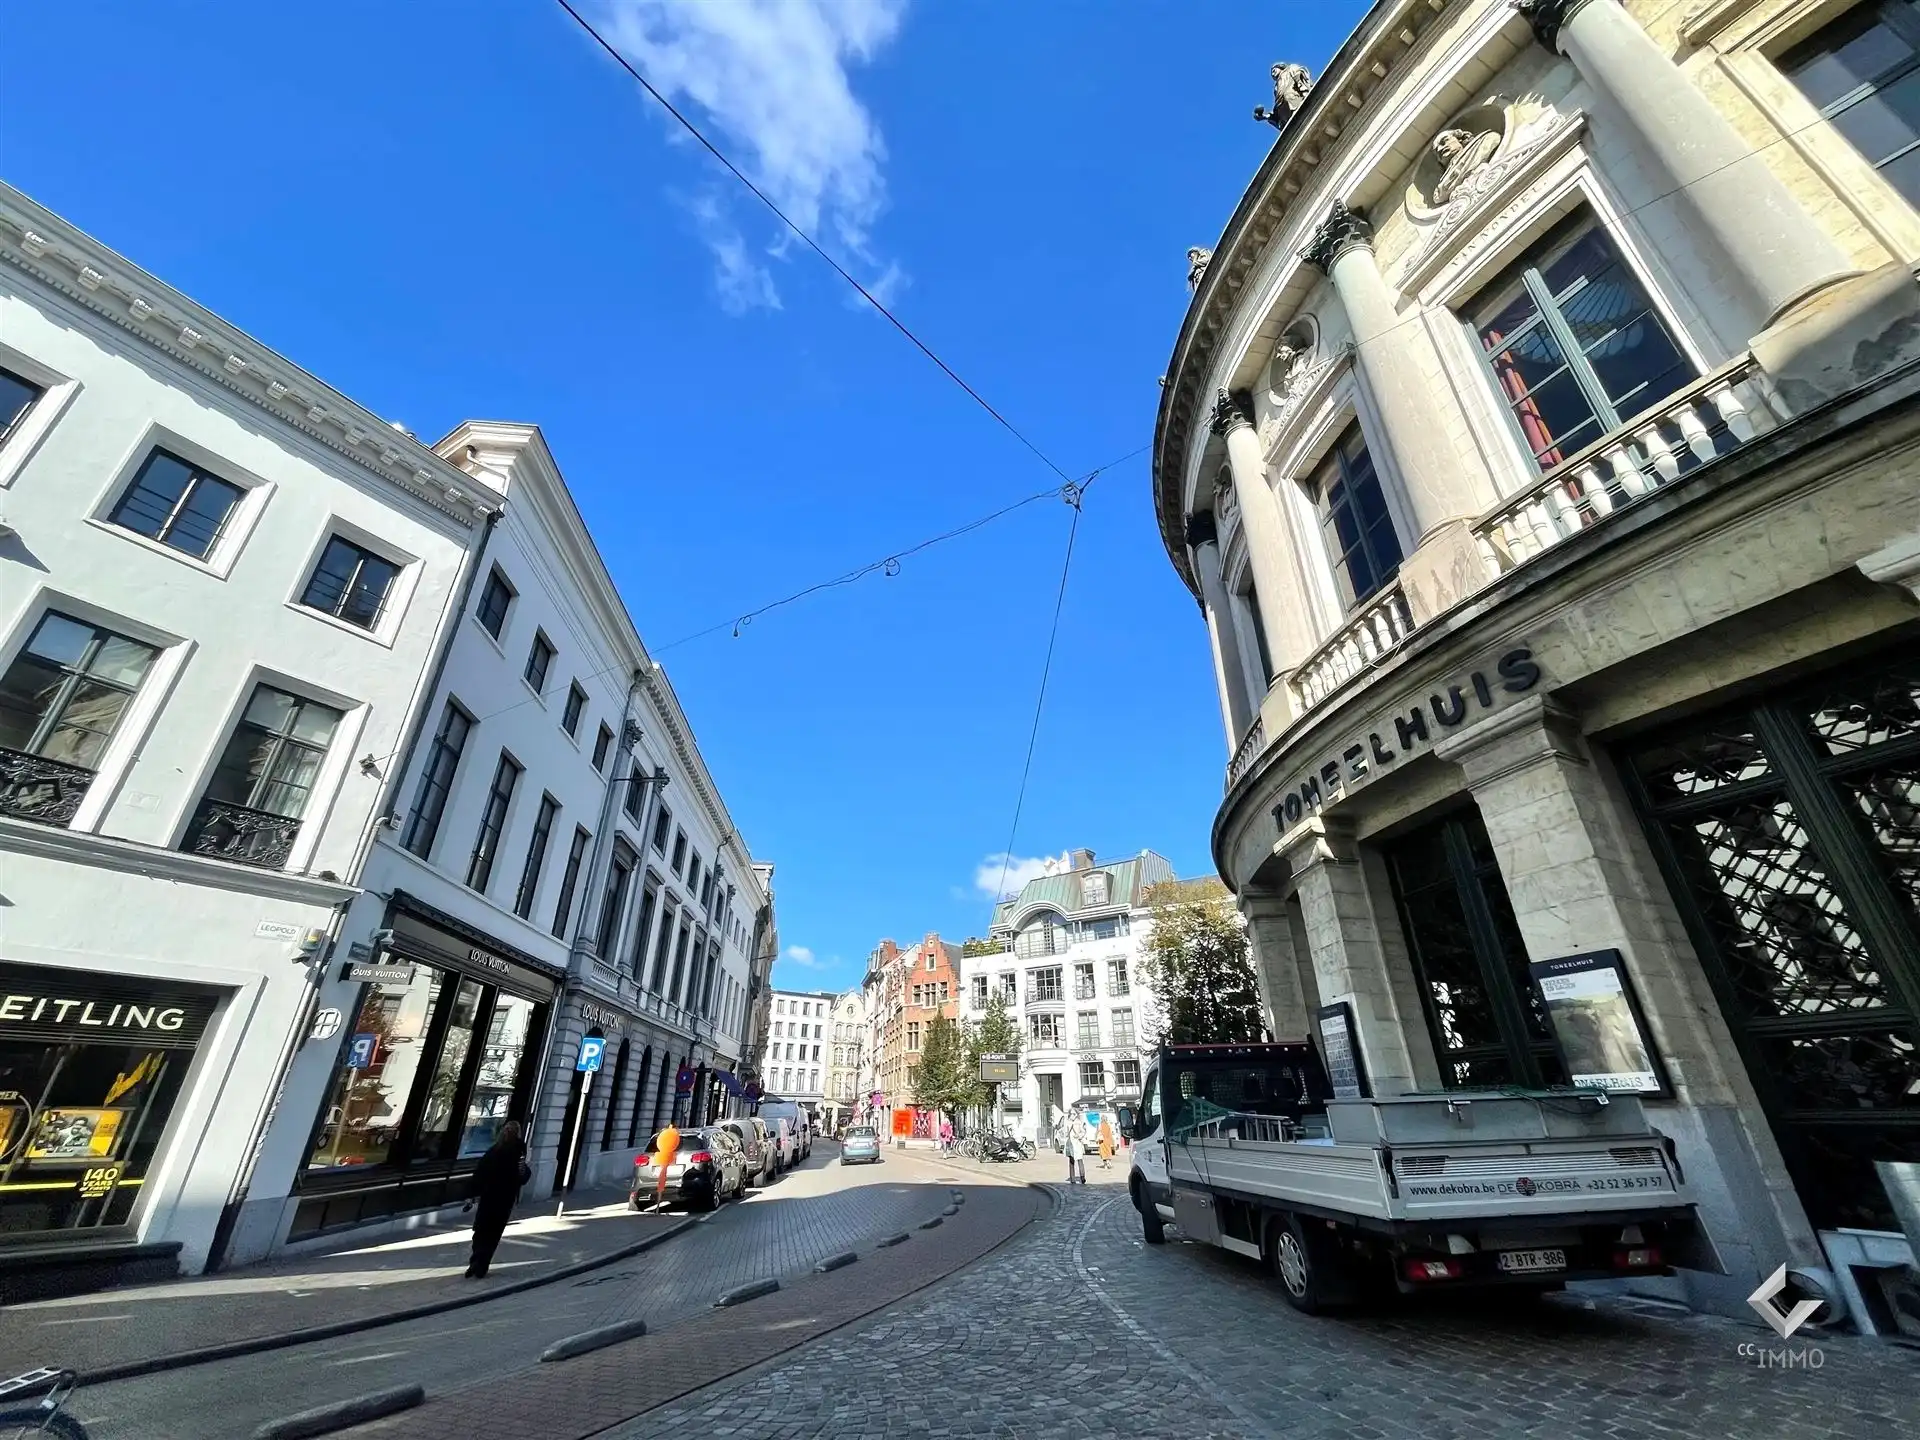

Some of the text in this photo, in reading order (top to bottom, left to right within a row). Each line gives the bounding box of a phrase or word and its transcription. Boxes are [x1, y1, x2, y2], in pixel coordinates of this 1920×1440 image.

[1271, 648, 1541, 833] TONEELHUIS
[470, 949, 511, 974] LOUIS VUITTON
[1550, 958, 1595, 971] TONEELHUIS
[375, 970, 409, 979] VUITTON
[582, 1003, 621, 1029] LOUIS VUITTON
[581, 1043, 600, 1065] P
[82, 1180, 113, 1188] YEARS
[83, 1167, 118, 1182] 140
[1409, 1176, 1662, 1196] www.dekobra.be DE KOBRA +32 52 36 57 57
